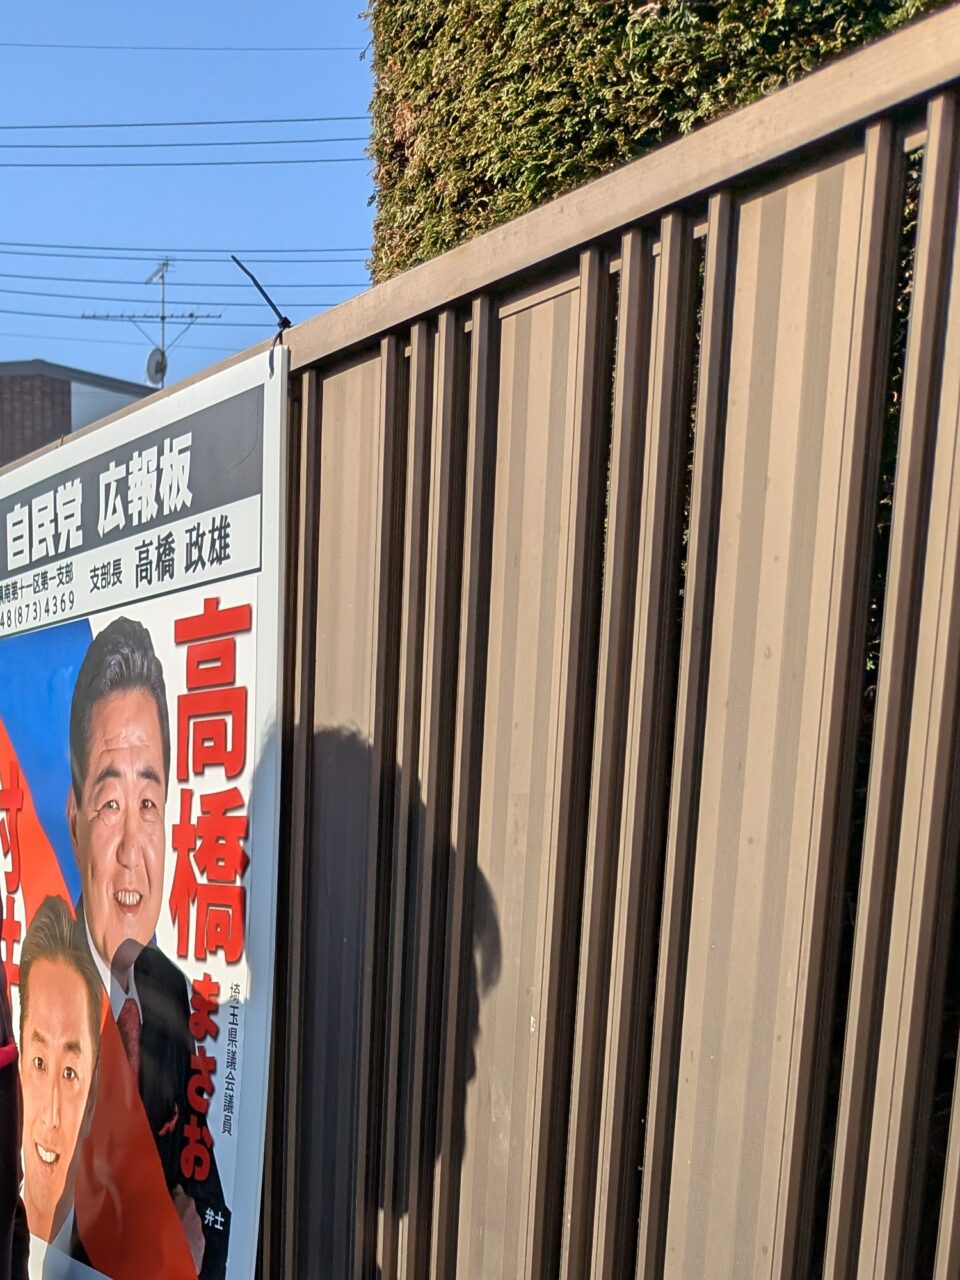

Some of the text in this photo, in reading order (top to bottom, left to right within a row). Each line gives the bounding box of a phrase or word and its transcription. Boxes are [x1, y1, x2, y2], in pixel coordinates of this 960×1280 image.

[6, 431, 193, 572] 自民党 広報板
[89, 557, 124, 594] 支部長
[134, 530, 176, 589] 高橋
[183, 514, 232, 575] 政雄
[168, 597, 253, 1182] 高橋 まさお
[221, 981, 241, 1137] 埼玉県議会議員
[204, 1207, 225, 1231] 弁士
